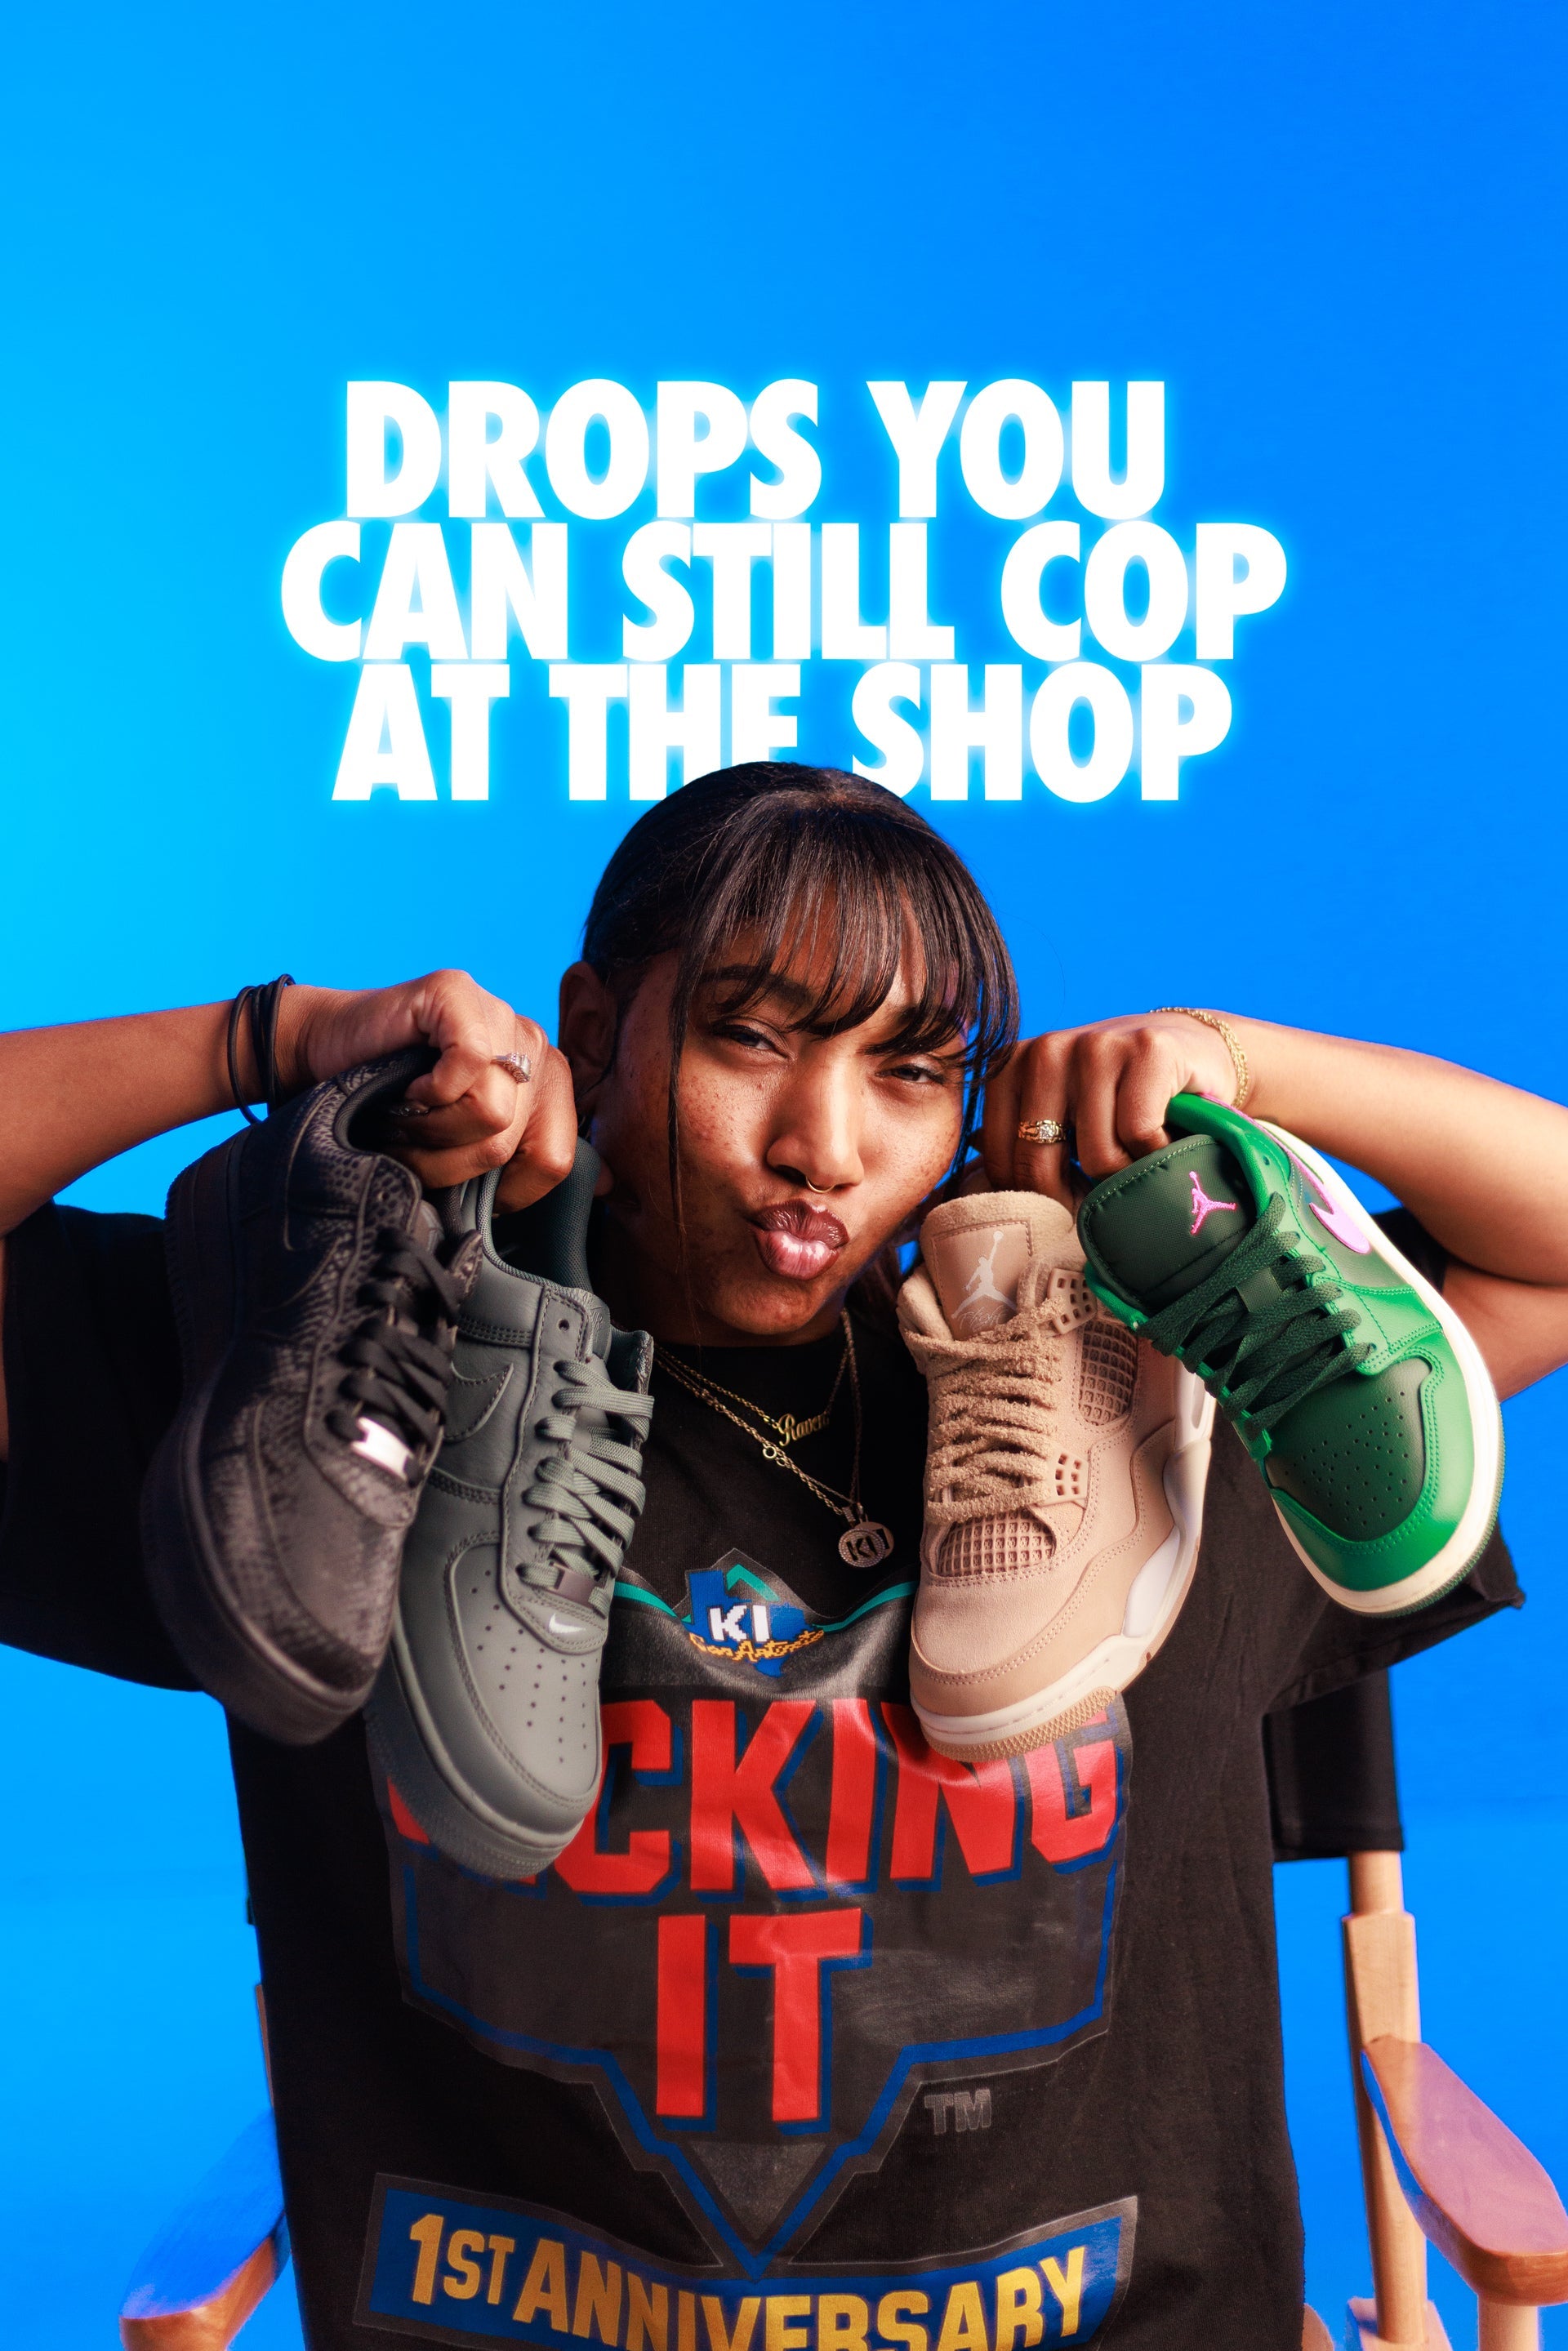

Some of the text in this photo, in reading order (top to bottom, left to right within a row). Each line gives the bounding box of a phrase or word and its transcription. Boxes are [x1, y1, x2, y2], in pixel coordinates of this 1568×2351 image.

[709, 1605, 771, 1643] KI
[387, 1697, 1117, 1896] CKING
[656, 1907, 867, 2130] IT
[924, 2088, 991, 2135] TM
[409, 2214, 1086, 2351] 1ST ANNIVERSARY
